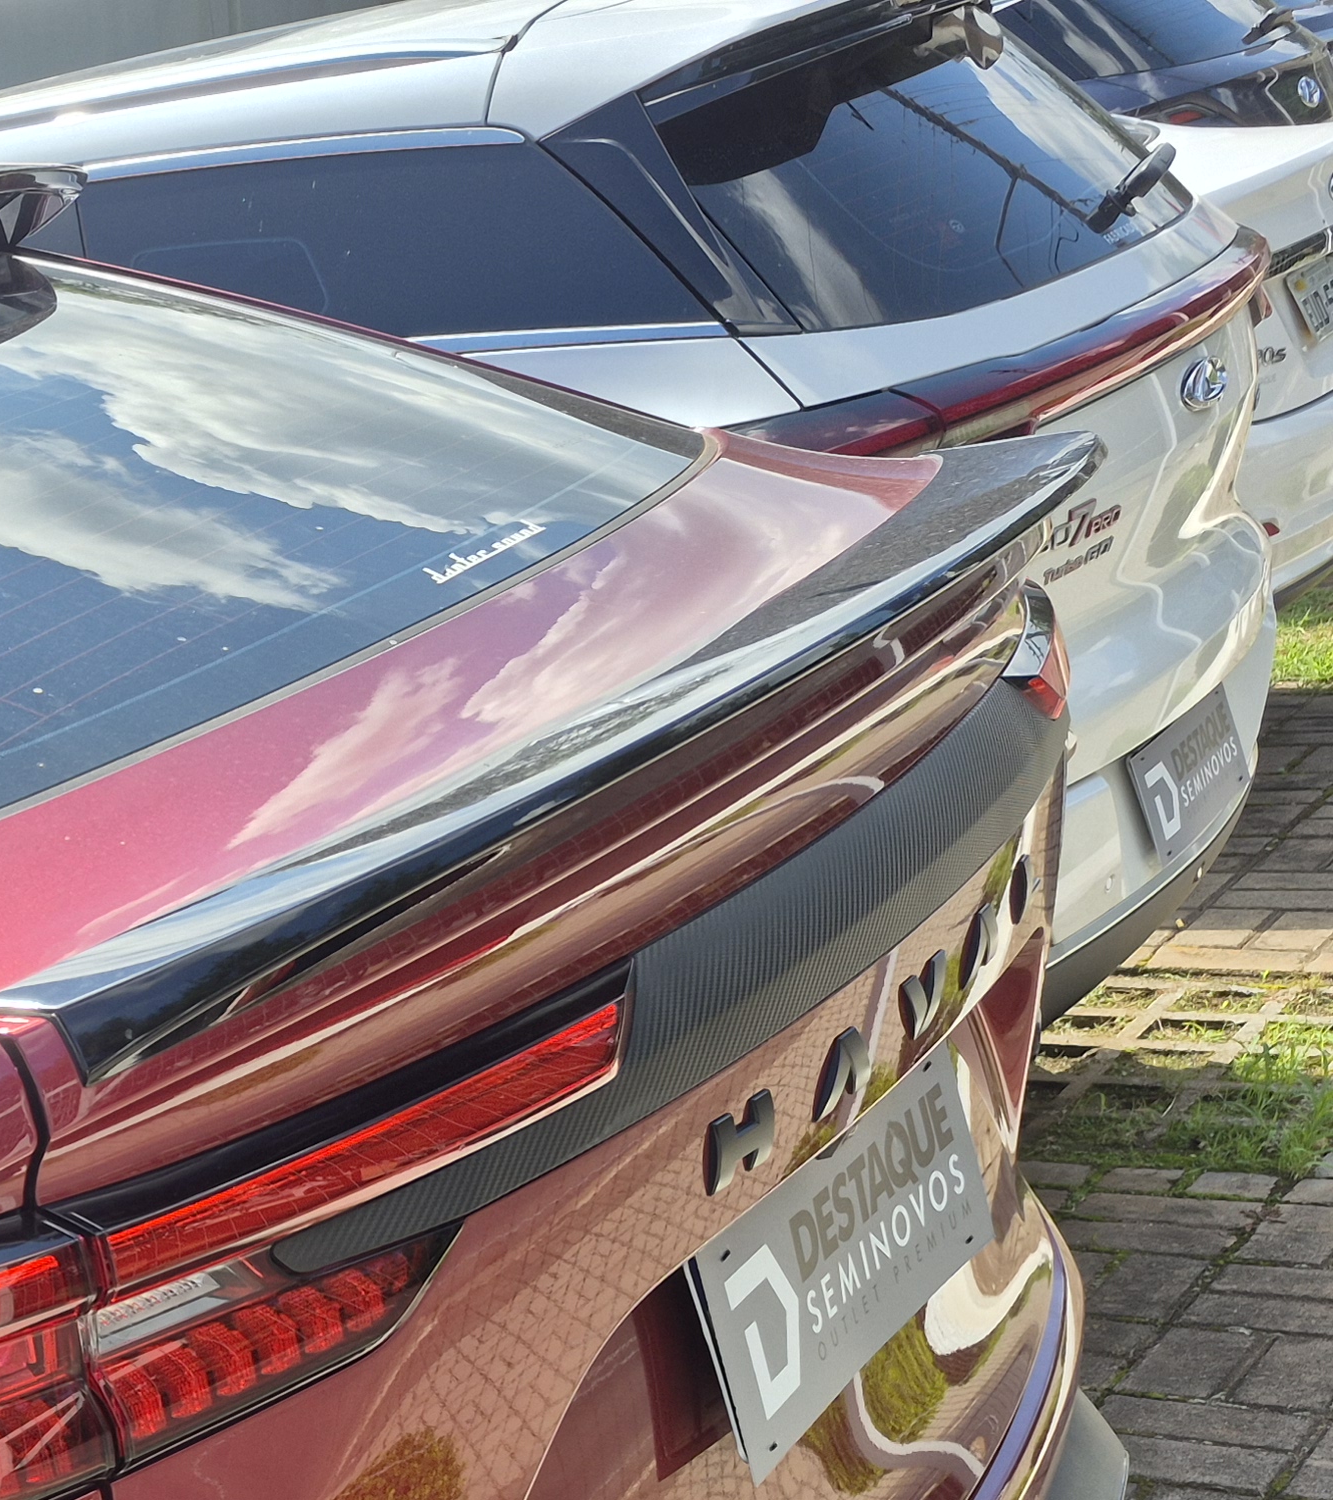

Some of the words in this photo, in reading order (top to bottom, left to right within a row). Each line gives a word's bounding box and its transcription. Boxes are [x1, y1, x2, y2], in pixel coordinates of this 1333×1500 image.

[491, 518, 547, 552] sound
[1170, 701, 1232, 782] DESTAQUE
[1180, 736, 1238, 807] SEMINOVOS
[789, 1083, 955, 1283] DESTAQUE
[806, 1153, 966, 1334] SEMINOVOS
[817, 1284, 883, 1361] OUTLET
[892, 1199, 973, 1285] PREMIUM
